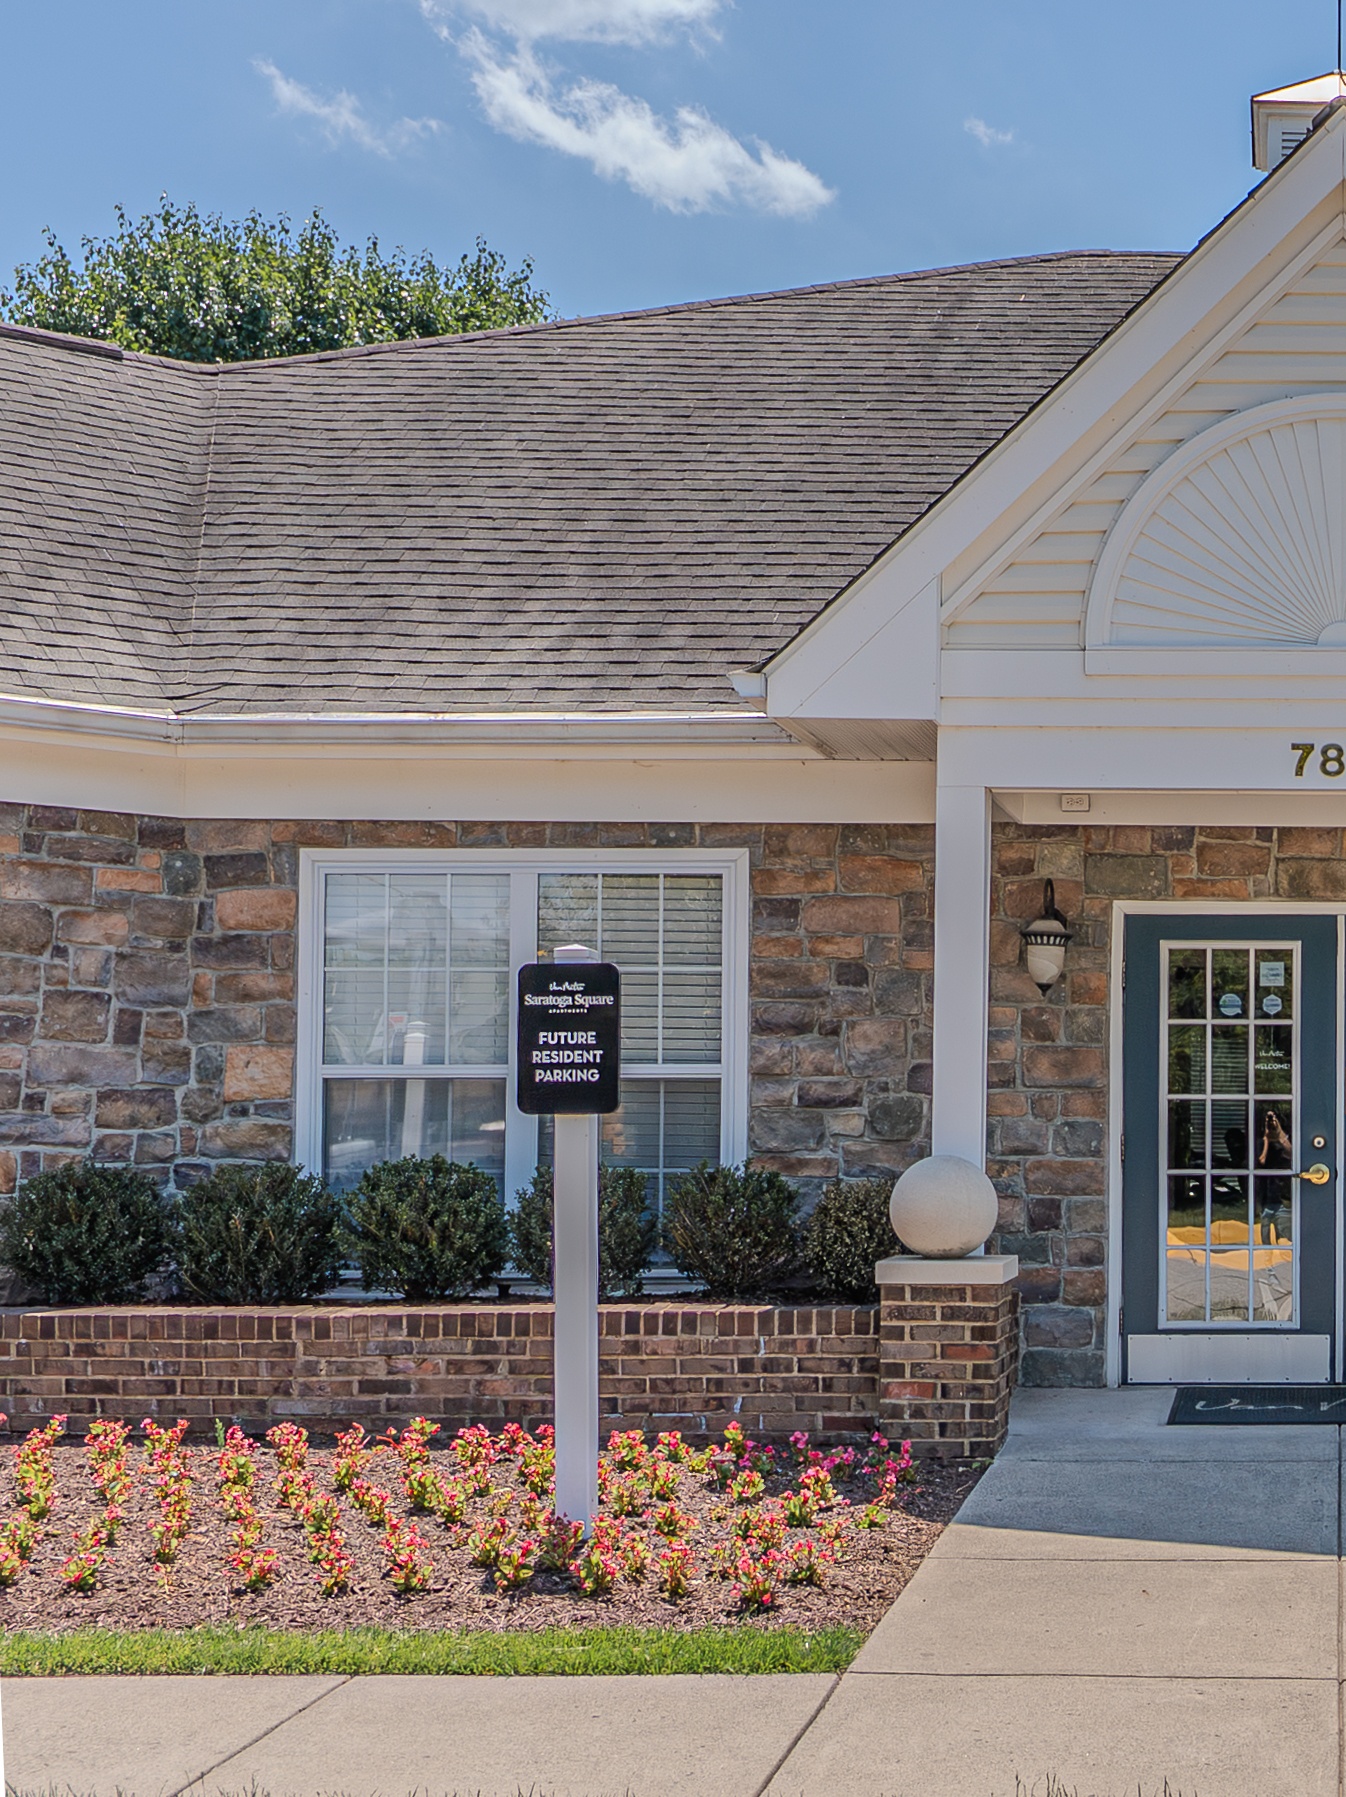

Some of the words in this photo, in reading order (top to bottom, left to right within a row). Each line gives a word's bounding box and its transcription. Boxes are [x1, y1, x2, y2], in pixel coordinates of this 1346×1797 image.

[524, 993, 573, 1008] Saratoga
[574, 993, 614, 1008] Square
[538, 1031, 597, 1045] FUTURE
[532, 1050, 603, 1064] RESIDENT
[535, 1069, 600, 1083] PARKING
